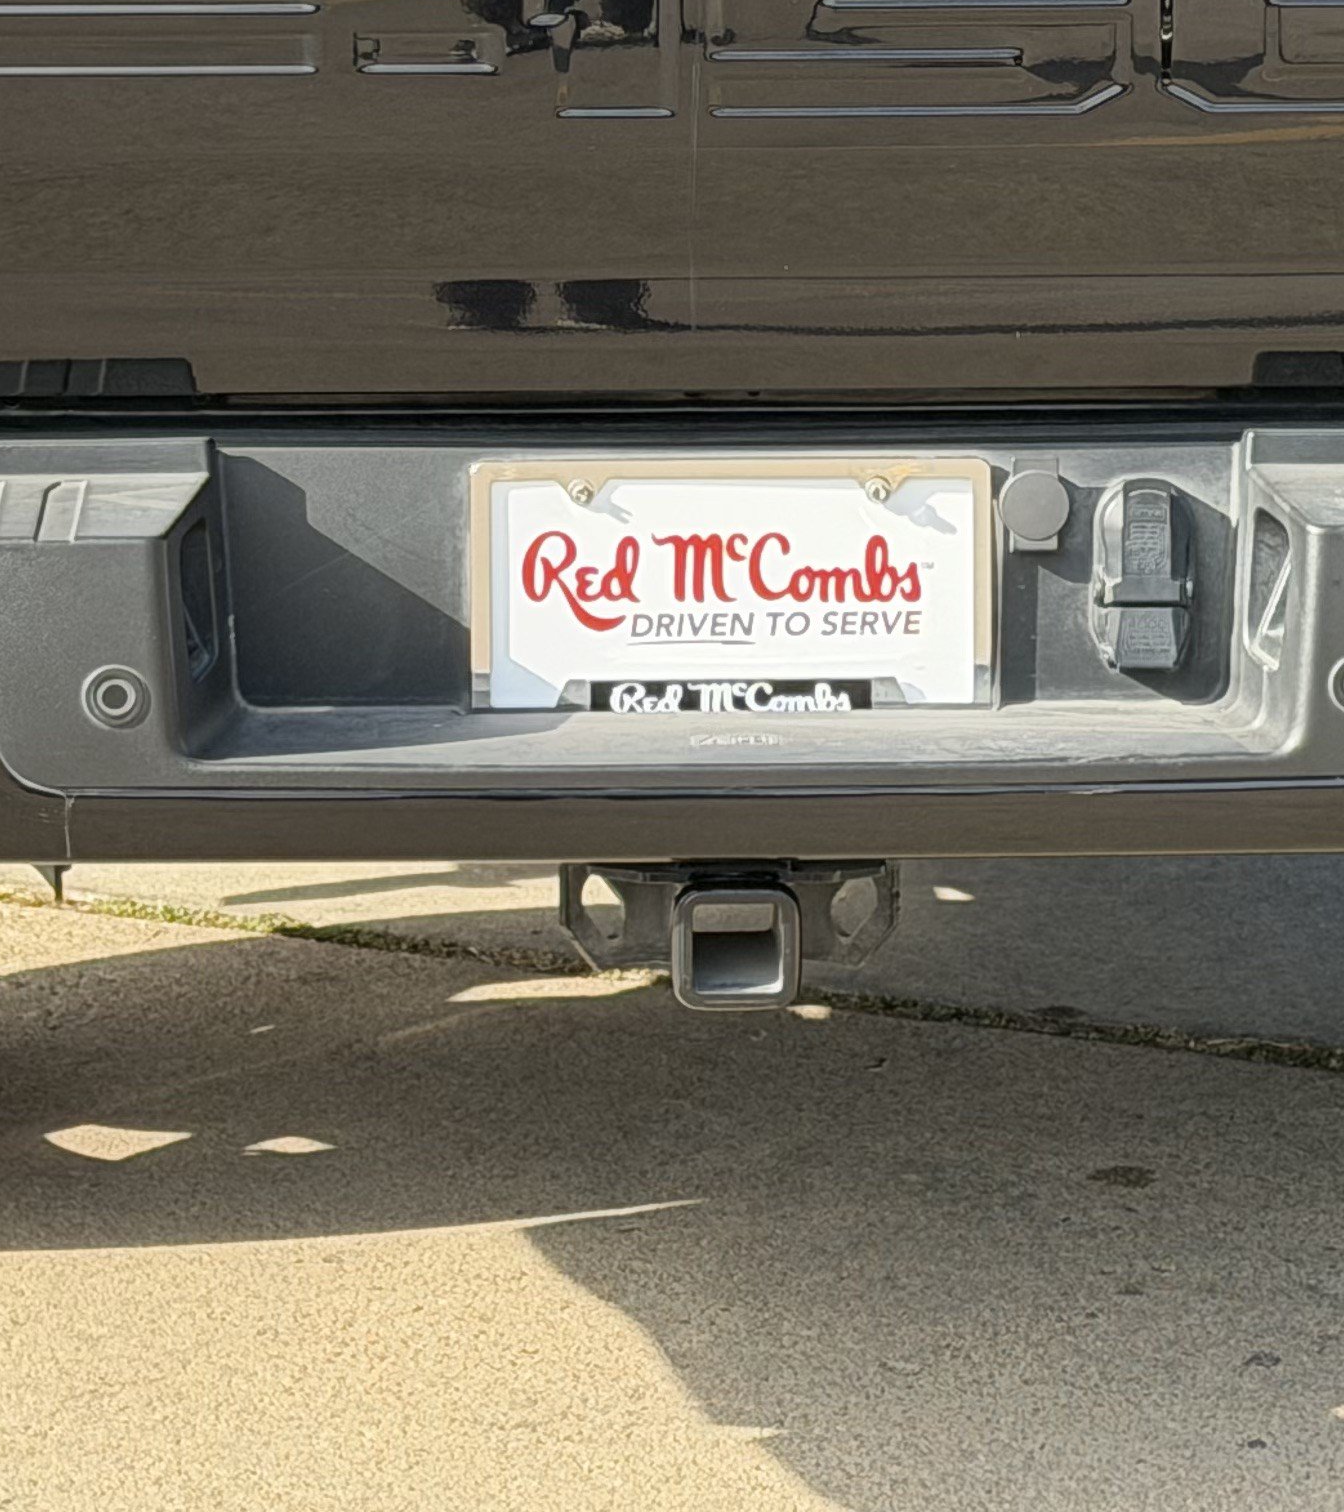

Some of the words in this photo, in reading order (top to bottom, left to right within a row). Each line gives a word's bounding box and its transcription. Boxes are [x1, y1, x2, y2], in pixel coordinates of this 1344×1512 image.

[521, 530, 642, 632] Red
[650, 532, 923, 605] McCombs
[629, 610, 755, 640] DRIVEN
[765, 610, 811, 638] TO
[819, 609, 923, 637] SERVE
[609, 682, 682, 714] Red
[687, 682, 853, 714] McCombs
